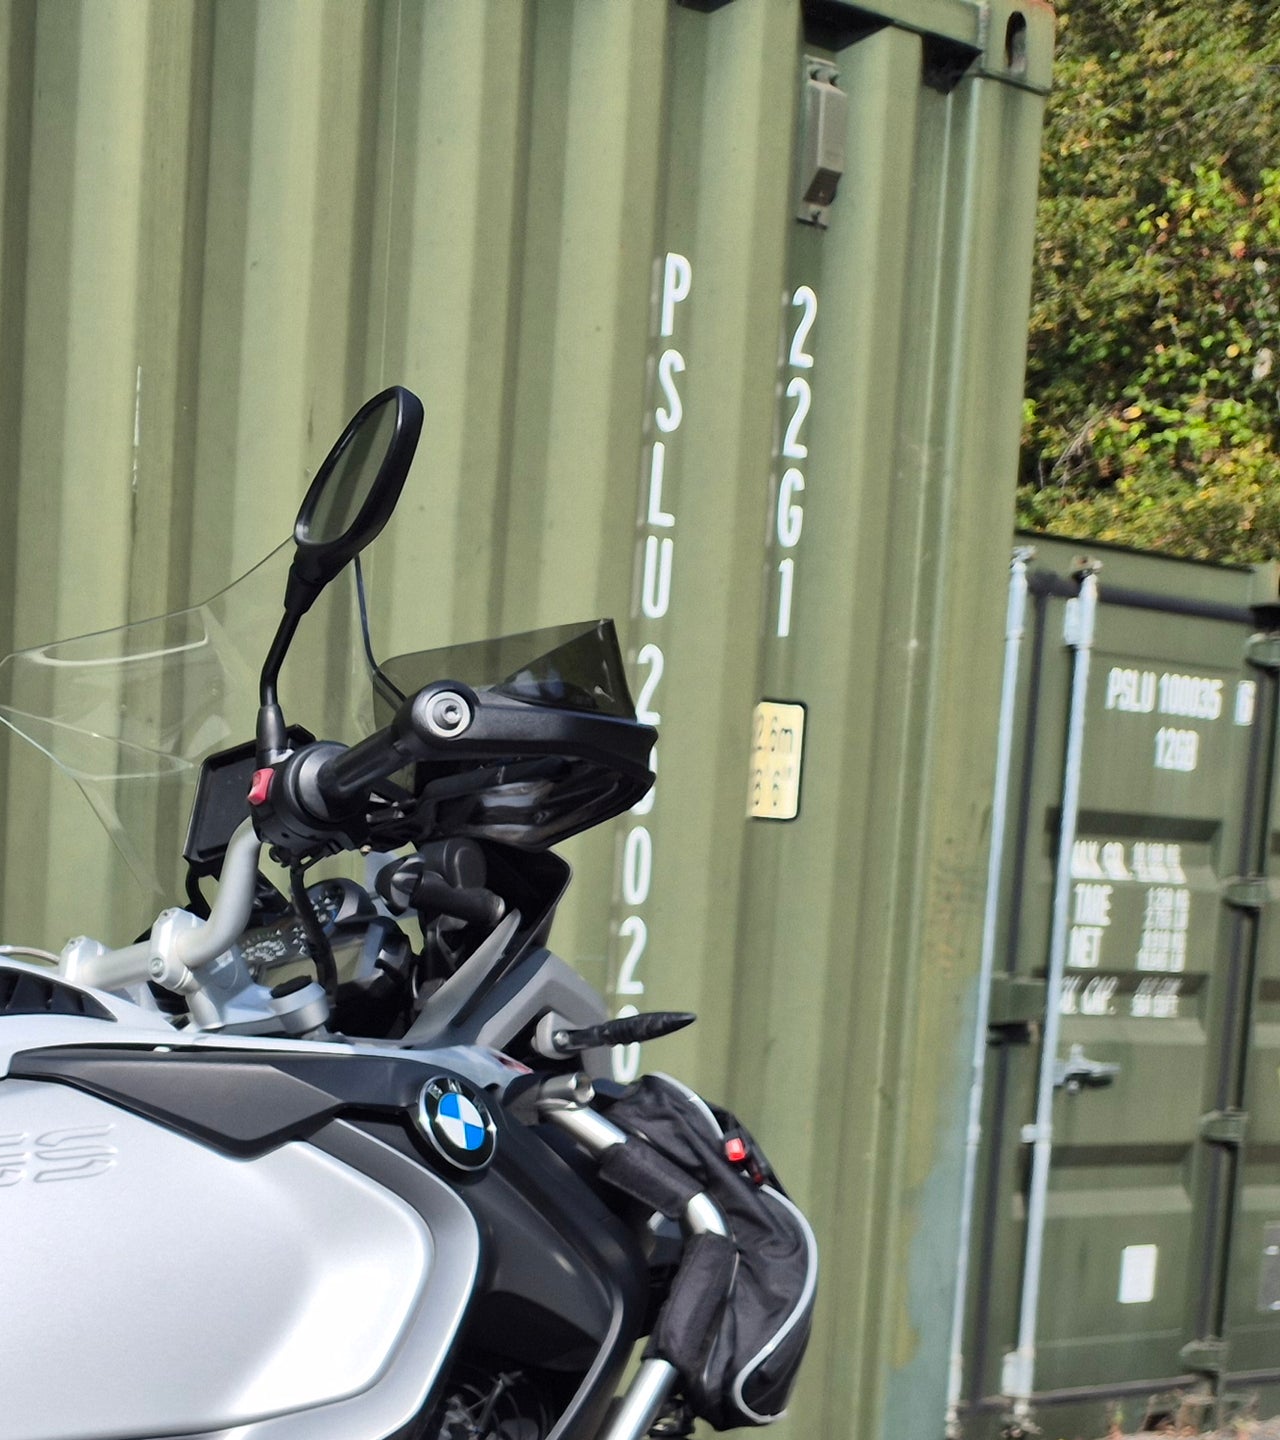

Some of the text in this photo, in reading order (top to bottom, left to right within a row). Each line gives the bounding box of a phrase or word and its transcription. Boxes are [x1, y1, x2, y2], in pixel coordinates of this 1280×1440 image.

[642, 252, 692, 618] PSLU
[776, 285, 818, 637] 22G1
[1105, 667, 1156, 713] PSLU
